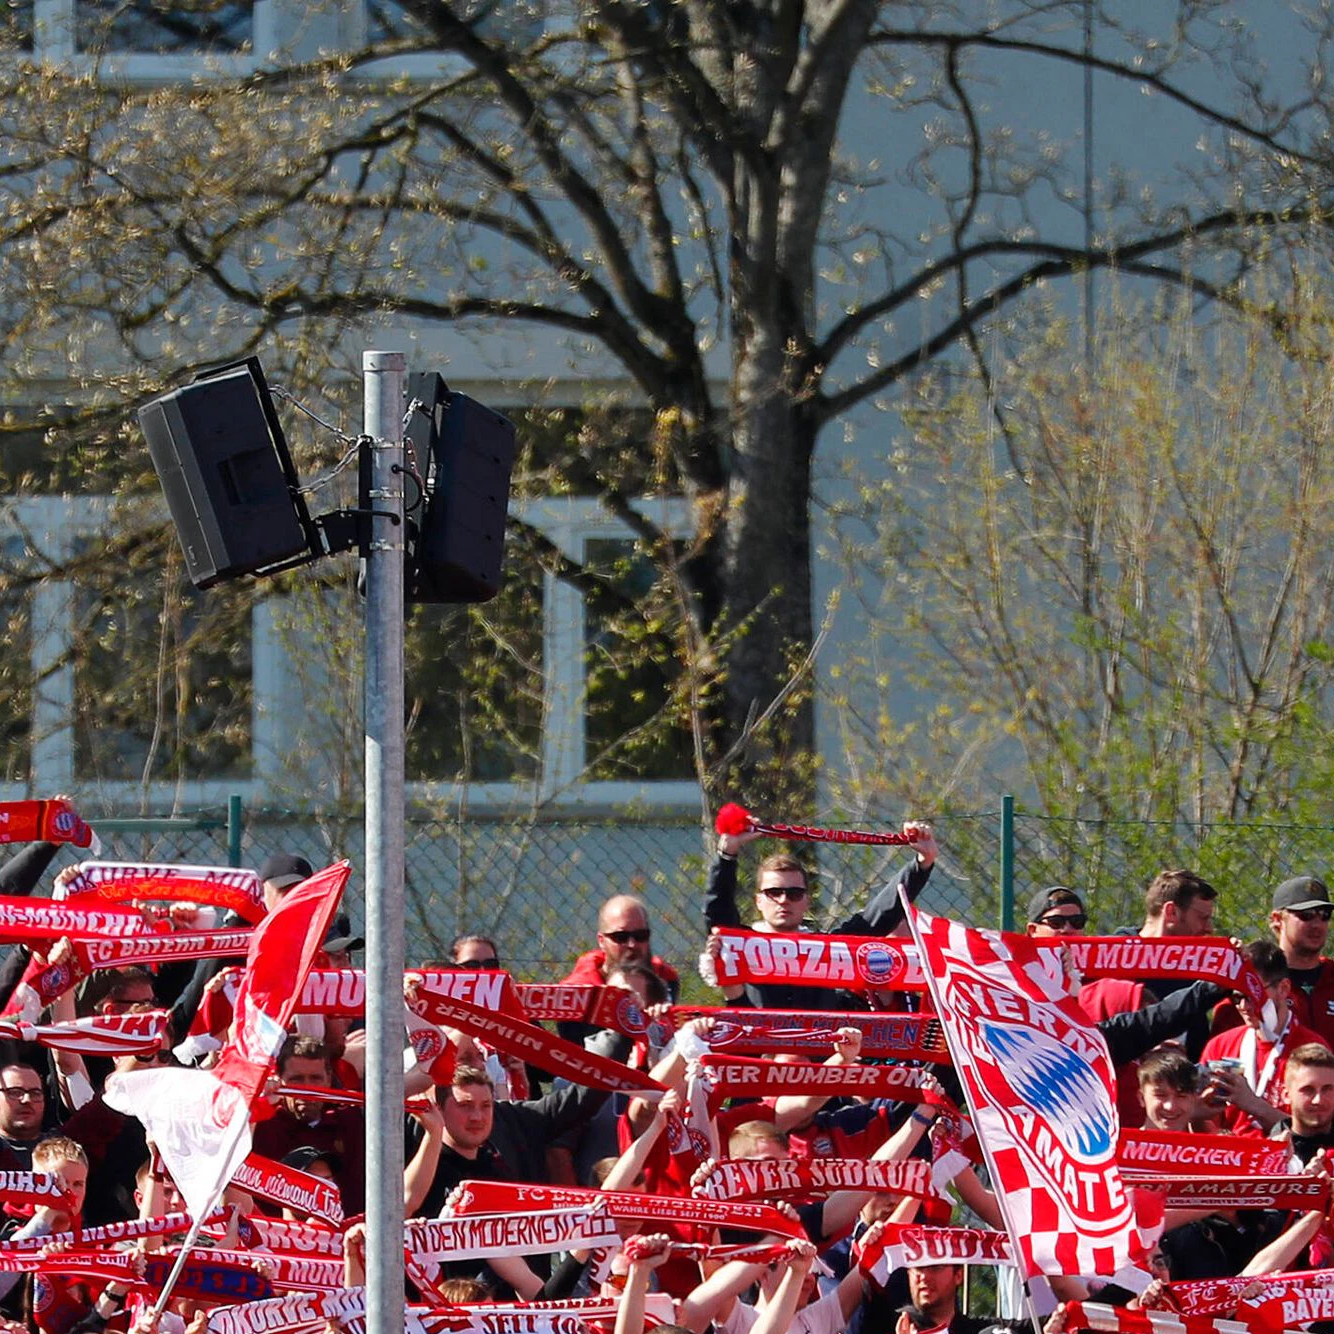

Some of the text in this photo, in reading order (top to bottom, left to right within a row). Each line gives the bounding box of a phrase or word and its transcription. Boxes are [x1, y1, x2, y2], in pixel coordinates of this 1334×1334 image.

[87, 941, 113, 964] FC
[720, 935, 854, 980] FORZA
[1096, 938, 1244, 980] MÜNCHEN
[771, 1063, 881, 1087] NUMBER
[1180, 1182, 1322, 1195] AMATEURE
[430, 1219, 466, 1252] DEN
[468, 1215, 571, 1249] MODERNEN
